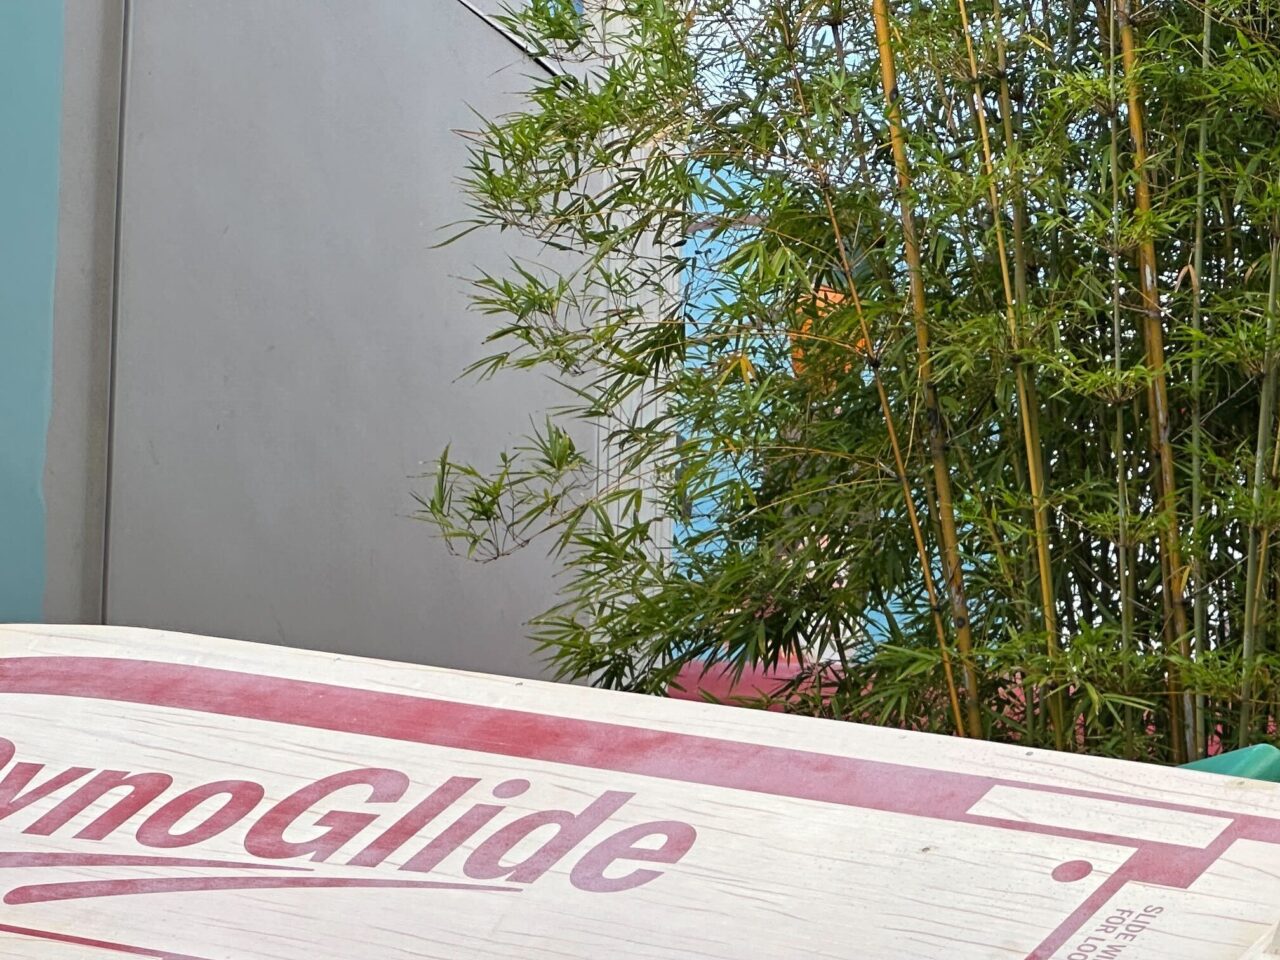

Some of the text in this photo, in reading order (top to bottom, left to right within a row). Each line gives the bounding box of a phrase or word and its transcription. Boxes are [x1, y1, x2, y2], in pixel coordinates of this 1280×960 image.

[0, 736, 698, 893] ynoGlide
[1095, 908, 1135, 934] FOR
[1115, 905, 1164, 942] SLIDE
